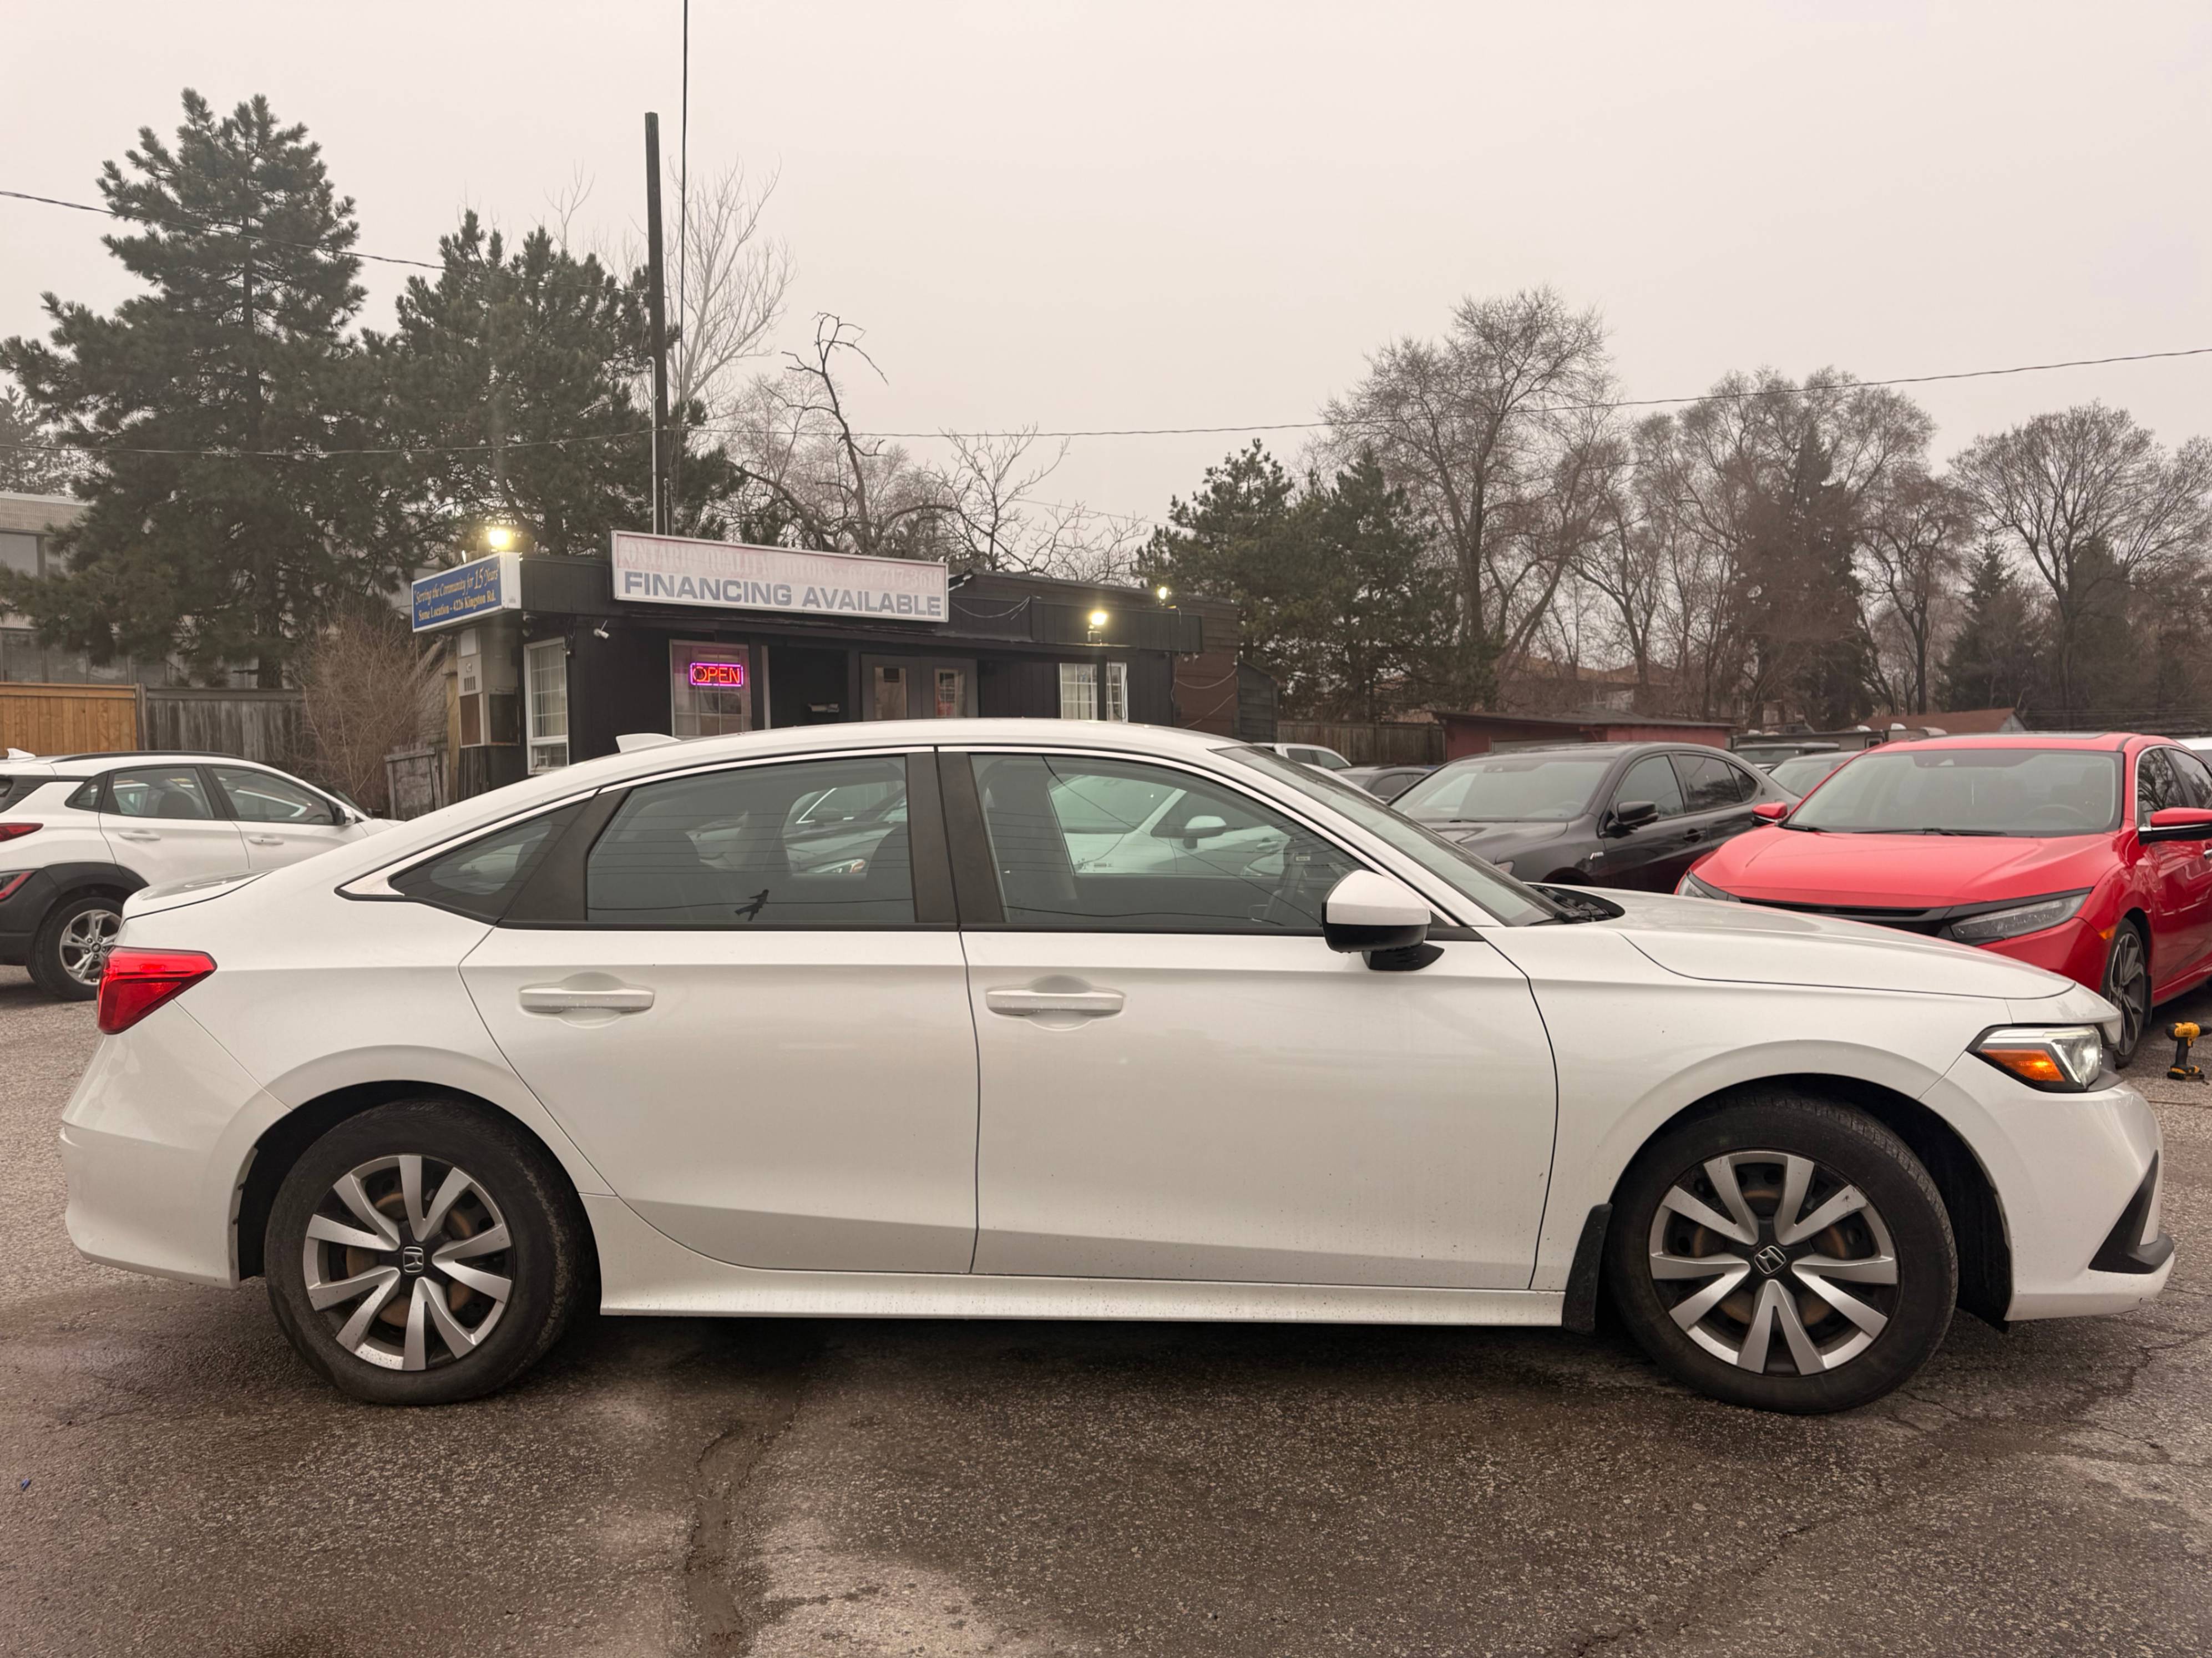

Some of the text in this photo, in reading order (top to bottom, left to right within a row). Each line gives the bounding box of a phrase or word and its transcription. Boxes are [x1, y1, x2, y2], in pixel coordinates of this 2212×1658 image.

[440, 578, 465, 596] Community
[465, 573, 474, 595] for
[474, 567, 483, 589] 15
[624, 571, 942, 616] FINANCING AVAILABLE
[431, 606, 449, 618] Location
[464, 595, 486, 610] Kingston
[693, 666, 740, 684] OPEN
